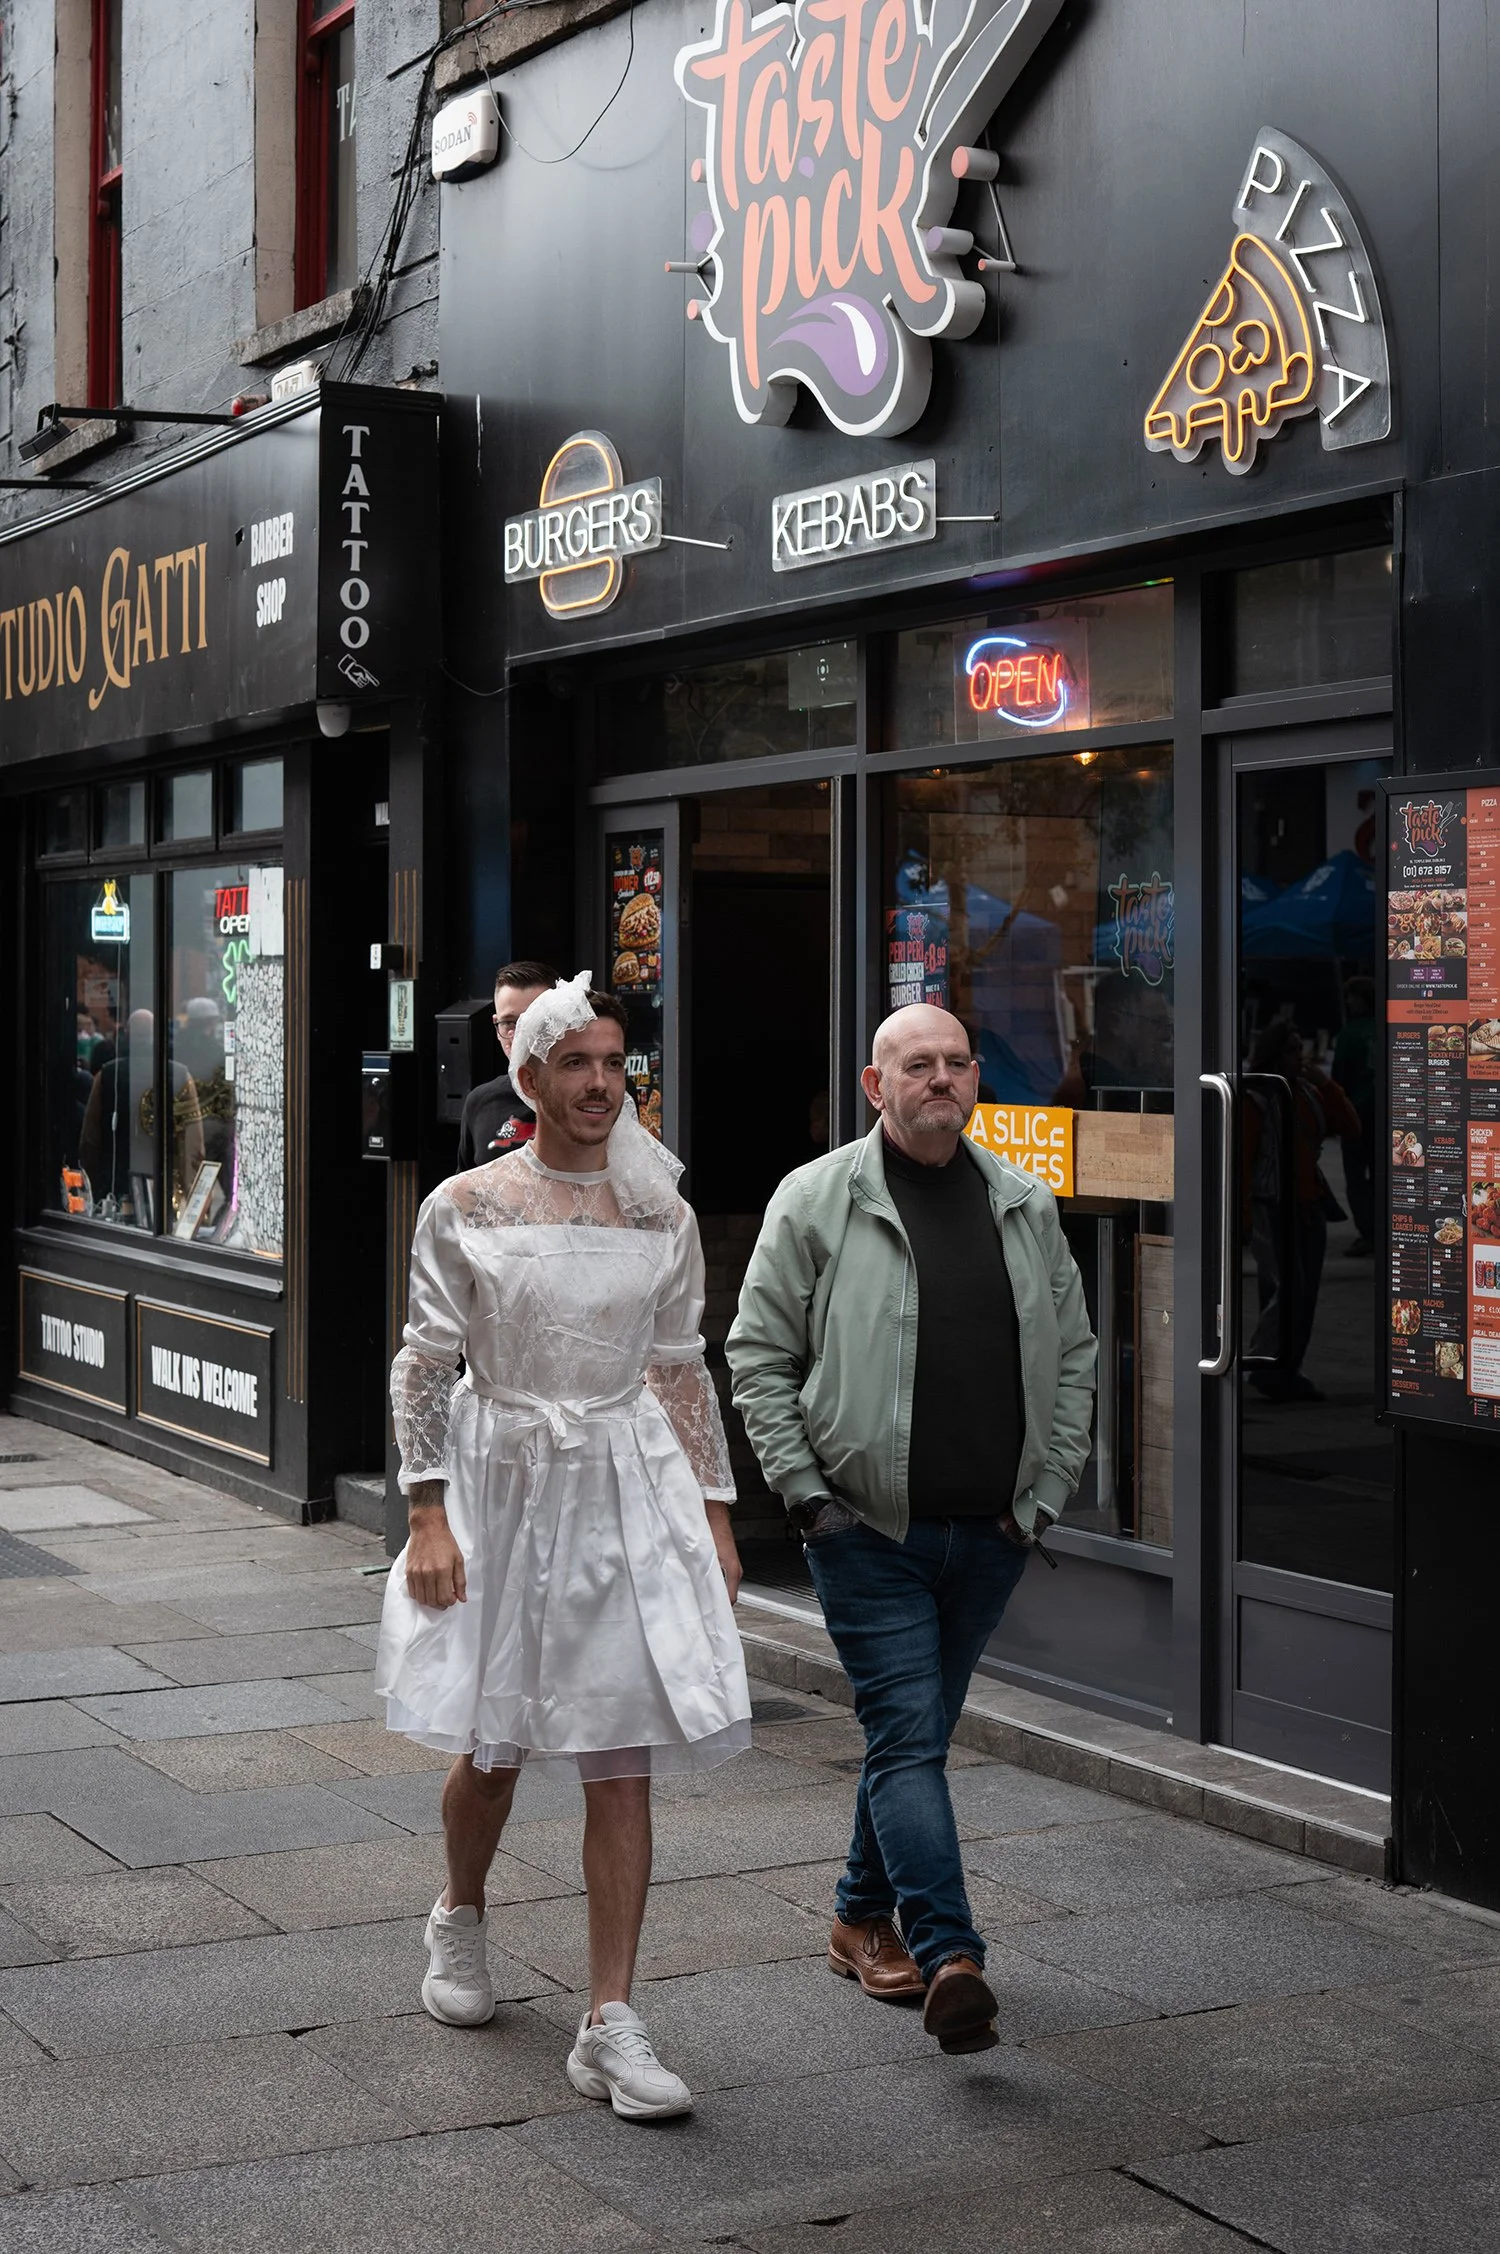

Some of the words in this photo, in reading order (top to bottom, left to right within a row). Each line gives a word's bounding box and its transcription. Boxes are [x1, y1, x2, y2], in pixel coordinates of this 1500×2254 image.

[690, 0, 921, 213] taste
[434, 124, 472, 156] SODAN
[742, 119, 937, 389] pick
[1238, 146, 1373, 425] PIZZA
[504, 488, 654, 575] BURGERS
[773, 472, 927, 561] KEBABS
[251, 512, 293, 567] BARBER
[339, 425, 370, 649] TATTOO
[256, 577, 286, 628] SHOP
[0, 585, 86, 700] TUDIO
[89, 542, 208, 711] GATTI
[970, 653, 1061, 710] OPEN
[1402, 802, 1440, 829] taste
[1481, 799, 1498, 807] PIZZA
[1411, 823, 1446, 850] pick
[1403, 865, 1417, 878] (01)
[1418, 866, 1433, 875] 672
[1434, 865, 1452, 875] 9157
[215, 886, 250, 918] TATT
[1112, 877, 1171, 927] taste
[889, 942, 906, 962] PERI
[907, 941, 924, 962] PERI
[924, 943, 946, 973] €8.99
[1124, 920, 1173, 970] pick
[890, 982, 921, 1008] BURGER
[970, 1109, 988, 1142] A
[993, 1110, 1064, 1147] SLICE
[1470, 1128, 1493, 1137] CHICKEN
[1471, 1136, 1488, 1144] WINGS
[1392, 1214, 1409, 1223] CHIPS
[1392, 1222, 1413, 1232] LOADED
[1414, 1224, 1430, 1233] FRIES
[1423, 1299, 1445, 1309] NACHOS
[1473, 1304, 1485, 1313] DIPS
[41, 1313, 72, 1358] TATTOO
[73, 1323, 105, 1369] STUDIO
[1392, 1337, 1409, 1347] SIDES
[151, 1345, 181, 1393] WALK
[182, 1353, 200, 1399] INS
[202, 1360, 257, 1418] WELCOME
[1392, 1379, 1420, 1391] DESSERTS
